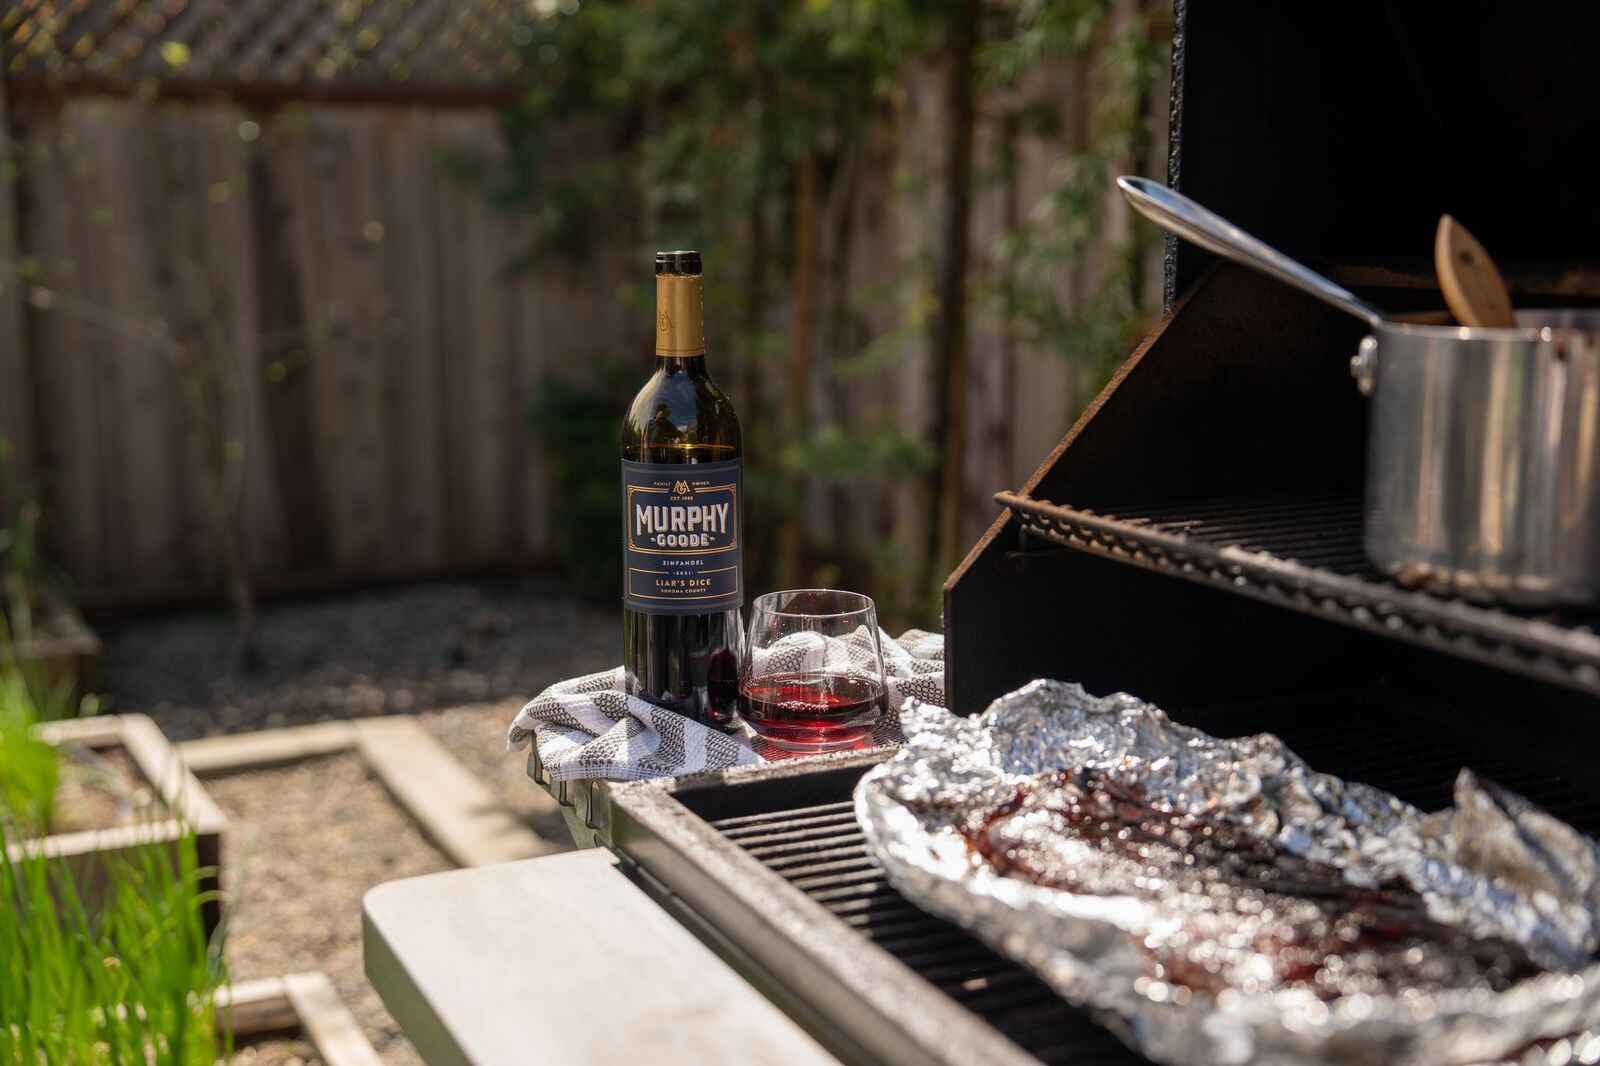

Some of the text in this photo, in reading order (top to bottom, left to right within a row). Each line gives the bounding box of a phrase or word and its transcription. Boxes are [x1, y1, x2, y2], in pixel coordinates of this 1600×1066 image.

[636, 503, 729, 536] MURPHY
[656, 534, 710, 547] GOODE
[656, 579, 711, 587] LIAR'S DICE
